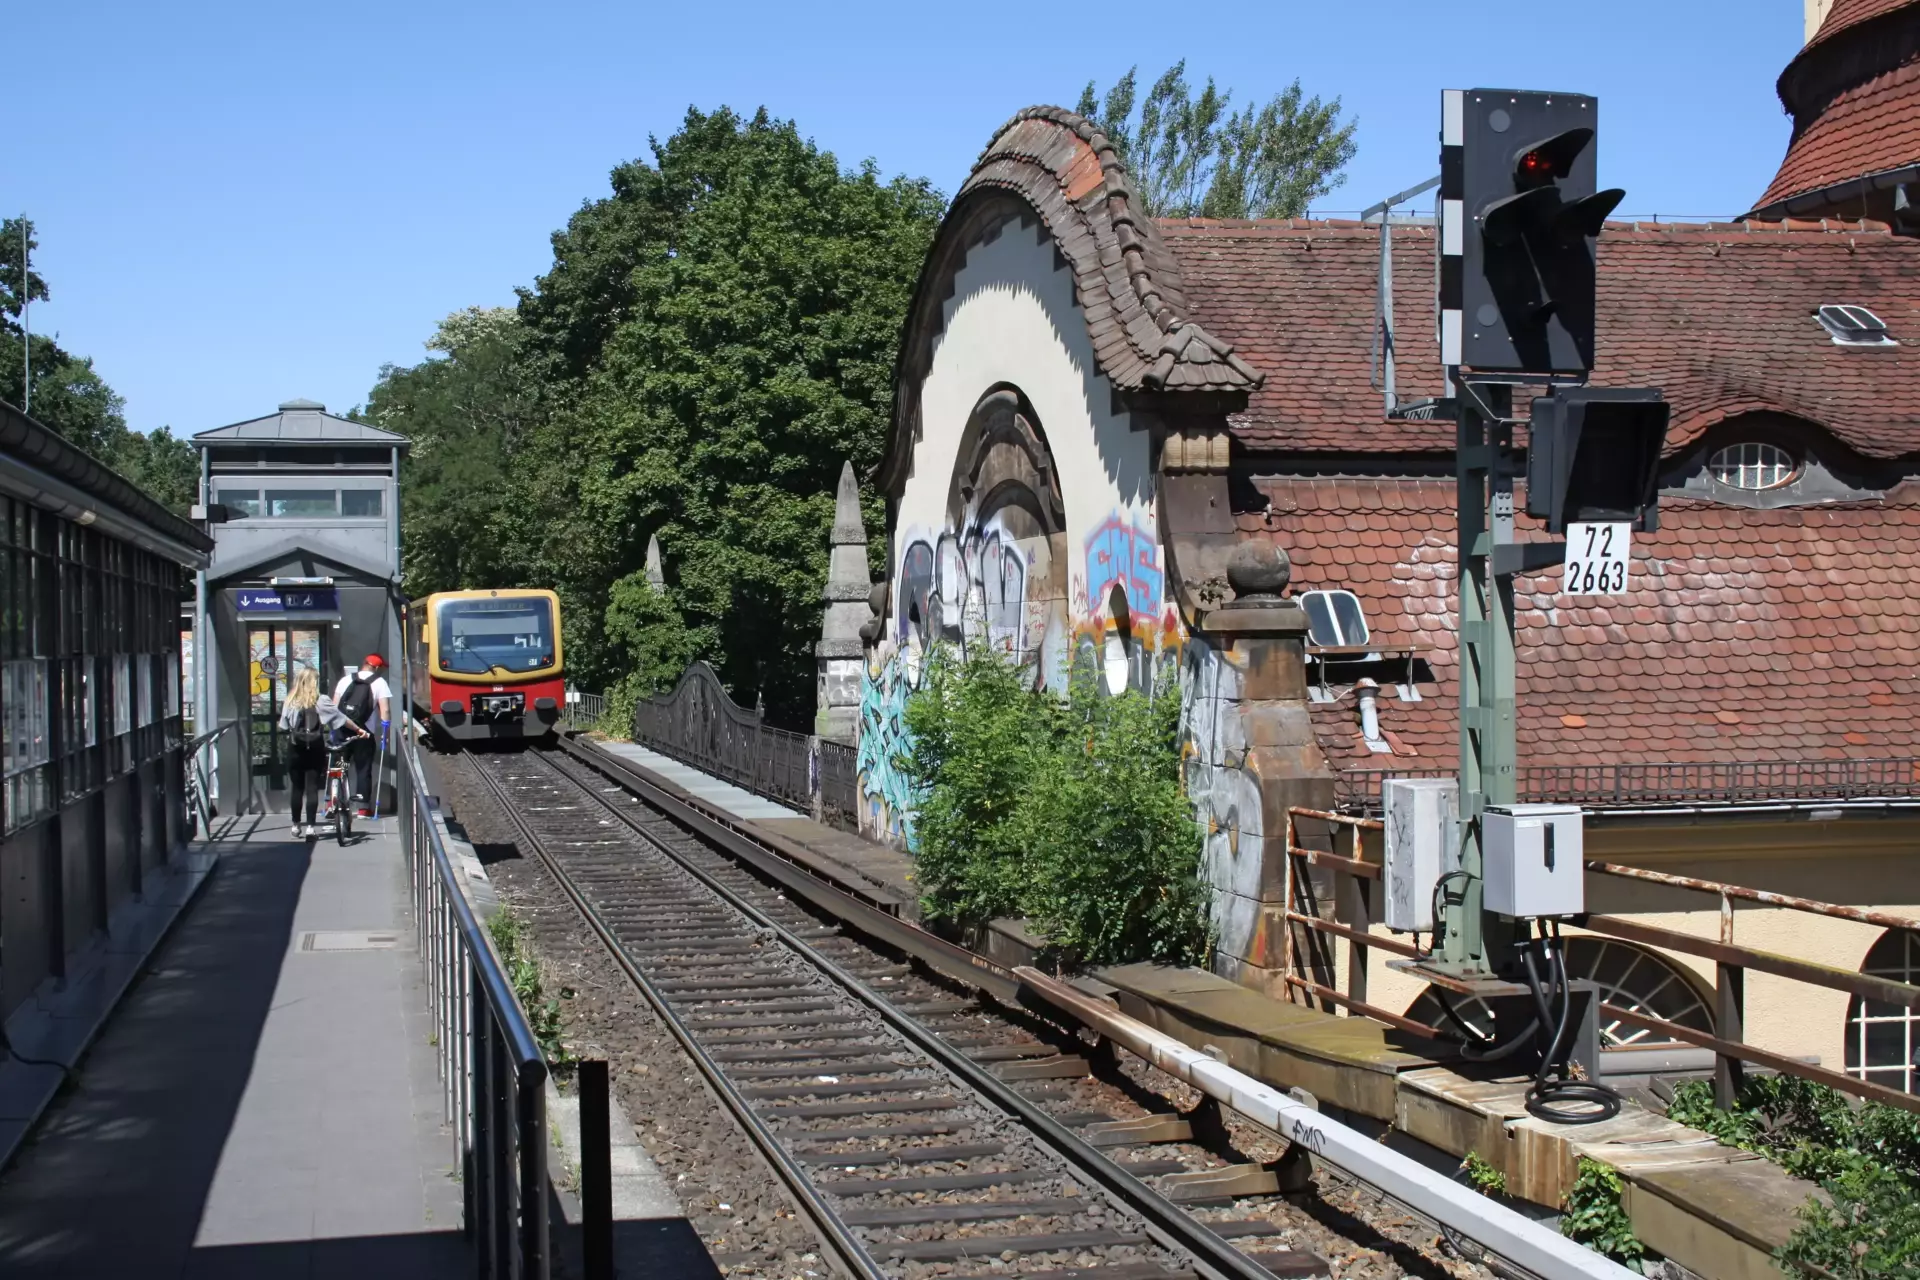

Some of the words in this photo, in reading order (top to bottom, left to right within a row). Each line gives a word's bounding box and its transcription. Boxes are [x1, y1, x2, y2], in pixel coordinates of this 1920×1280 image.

[1585, 526, 1612, 557] 72
[1567, 561, 1624, 592] 2663
[254, 596, 282, 605] Ausgang
